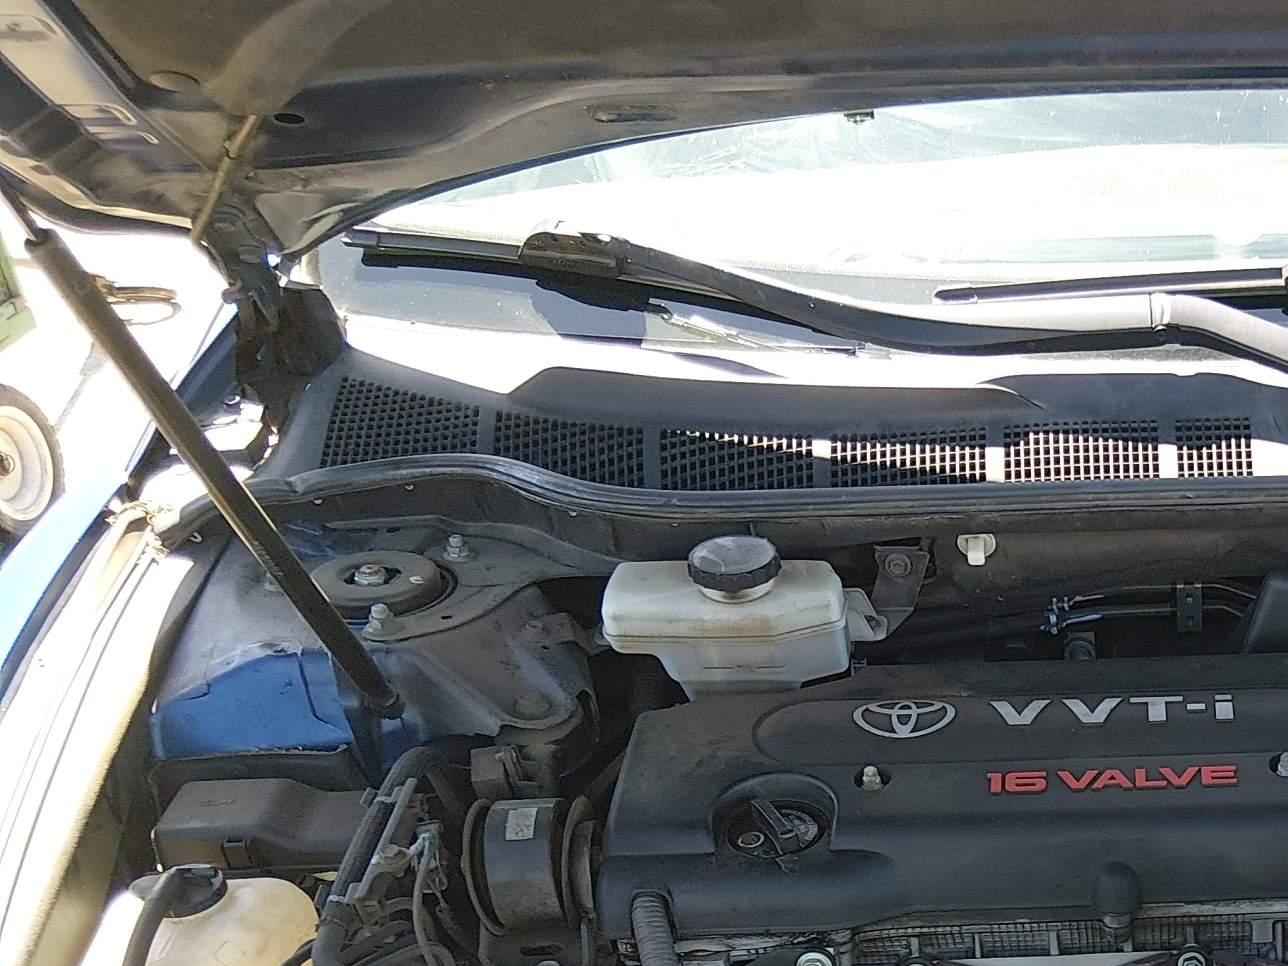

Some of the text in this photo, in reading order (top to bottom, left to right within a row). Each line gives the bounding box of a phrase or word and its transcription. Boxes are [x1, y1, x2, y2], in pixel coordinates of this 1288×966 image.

[989, 694, 1234, 725] VVT-i
[986, 764, 1239, 794] 16 VALVE
